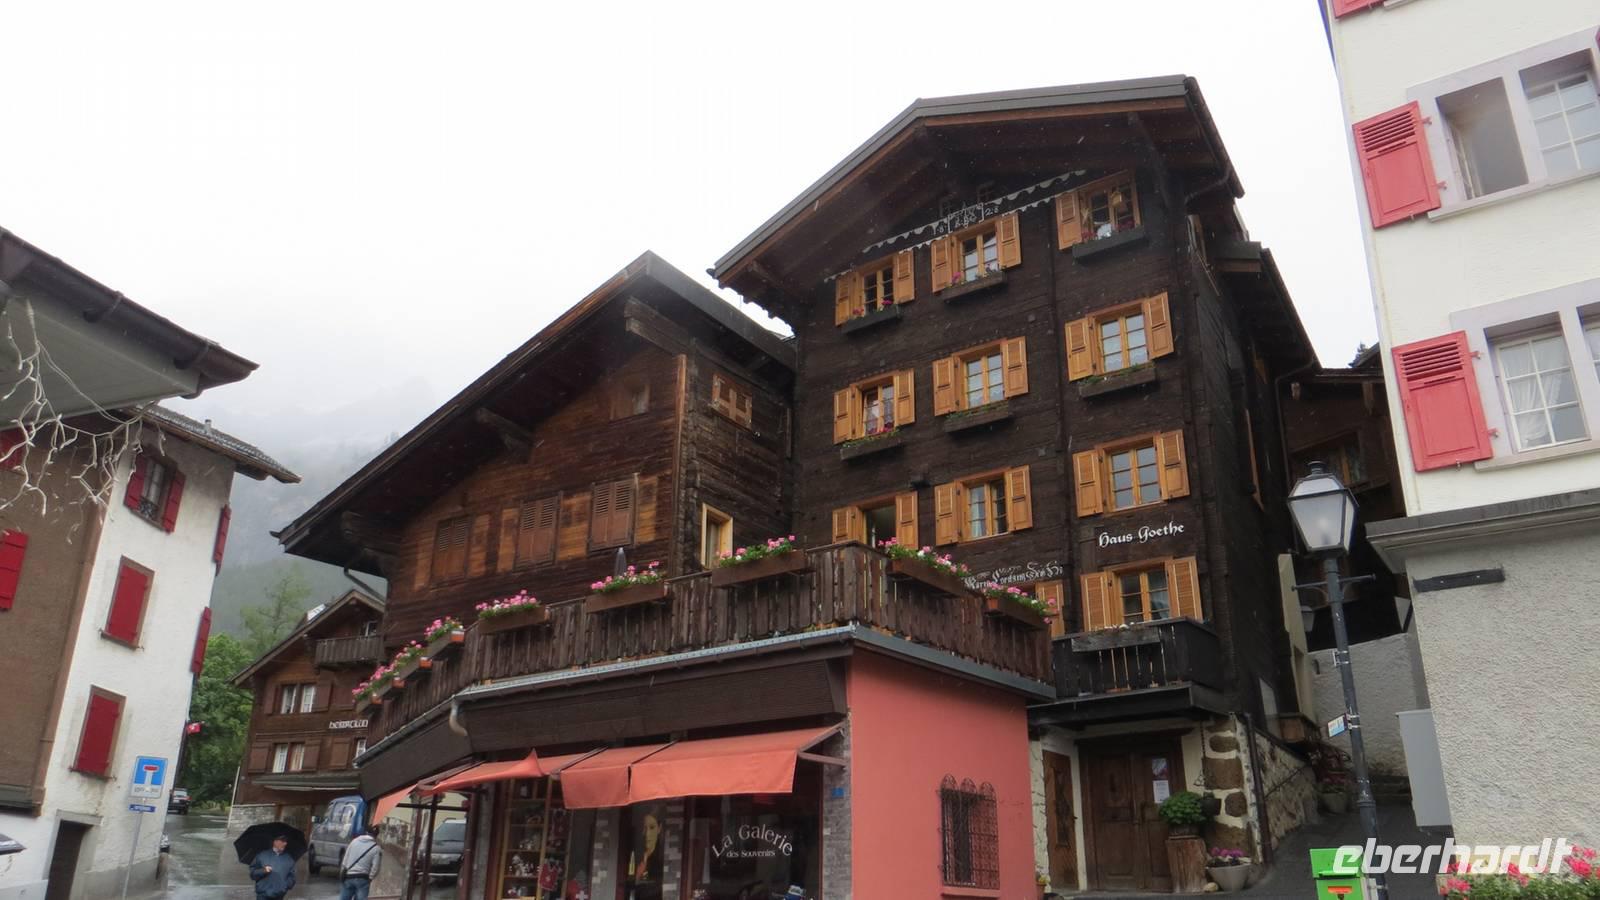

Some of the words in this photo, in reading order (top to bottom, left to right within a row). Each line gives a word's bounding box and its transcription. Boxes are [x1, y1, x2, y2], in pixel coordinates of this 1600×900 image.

[1099, 532, 1133, 548] Haus
[1138, 521, 1185, 544] Goethe
[711, 834, 733, 858] La
[738, 824, 793, 856] Galerie
[726, 849, 739, 858] des
[741, 849, 776, 858] Souvenirs
